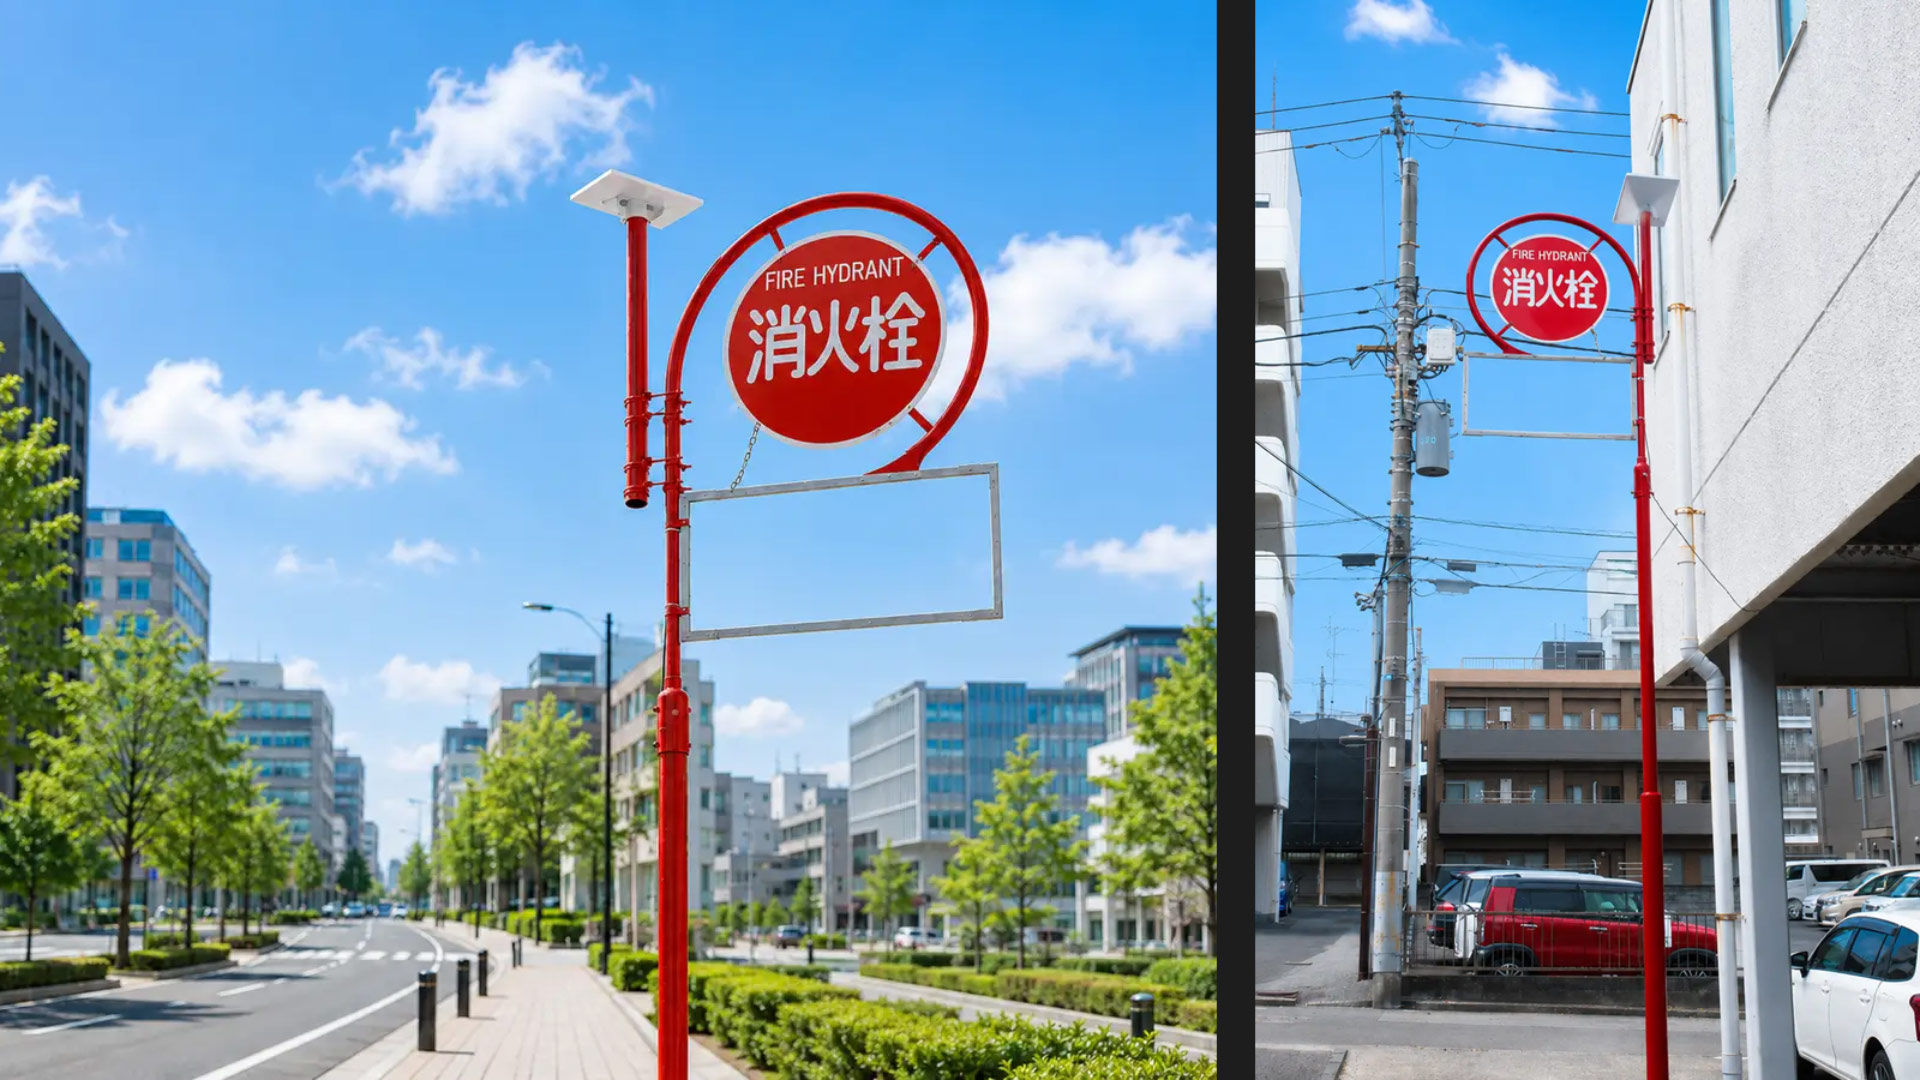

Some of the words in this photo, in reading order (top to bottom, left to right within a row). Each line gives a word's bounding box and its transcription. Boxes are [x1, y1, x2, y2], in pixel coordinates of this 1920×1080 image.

[765, 268, 806, 291] FIRE
[813, 256, 904, 286] HYDRANT
[1512, 249, 1535, 260] FIRE
[1538, 250, 1587, 262] HYDRANT
[1503, 267, 1599, 309] 消火栓
[747, 292, 926, 384] 消火栓
